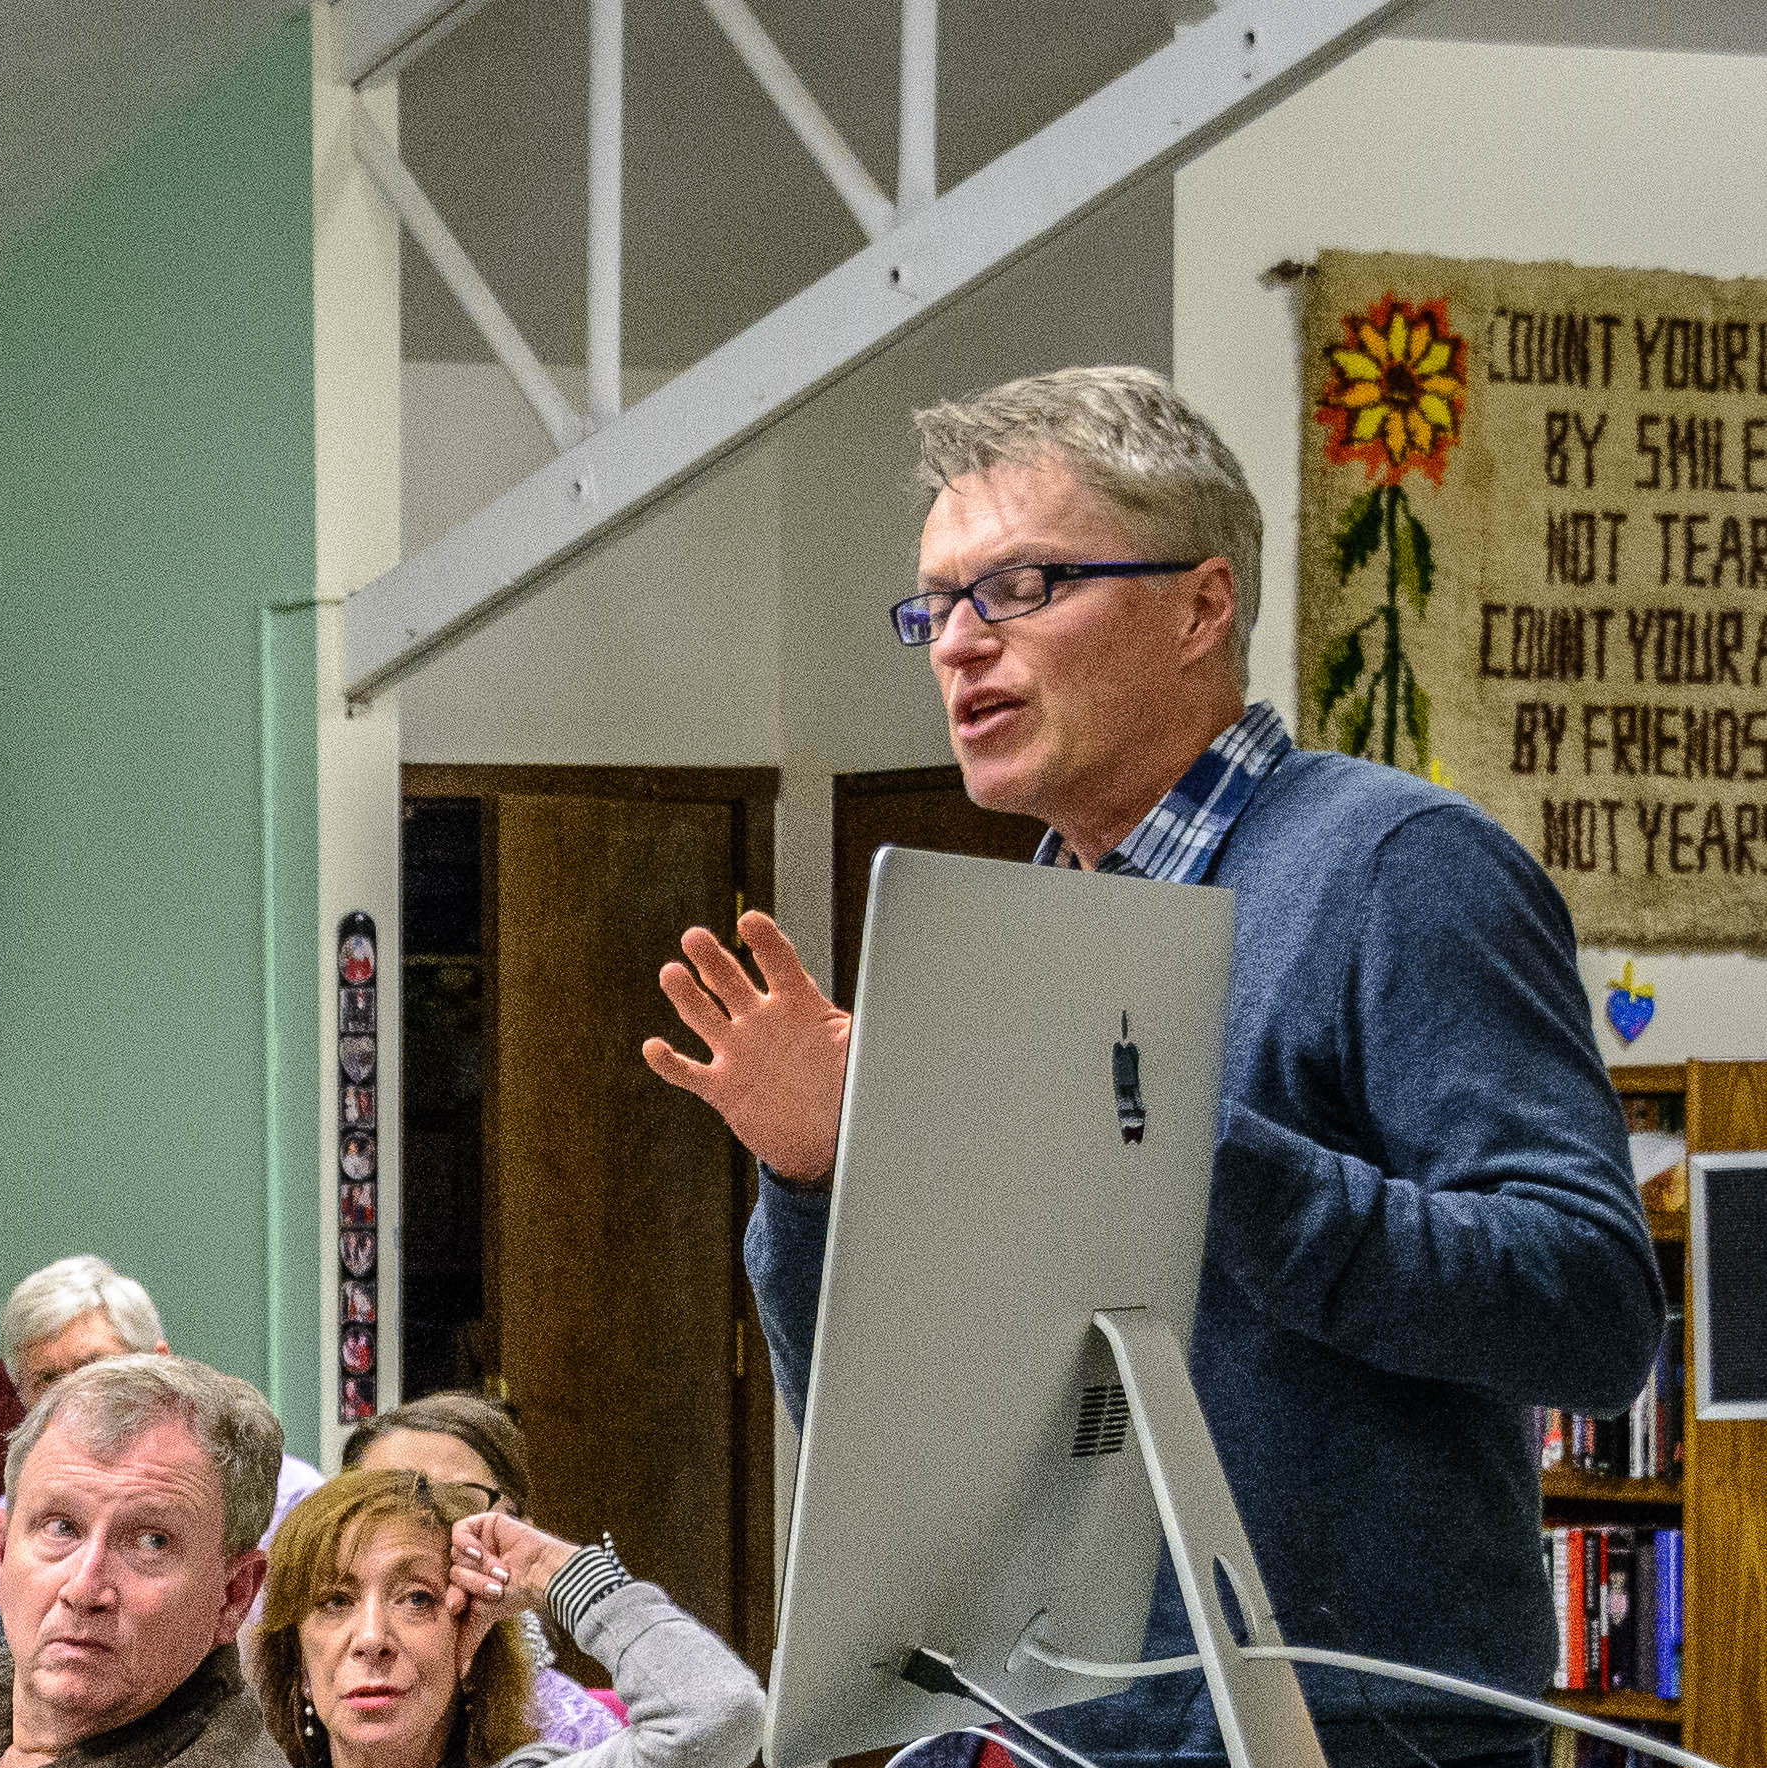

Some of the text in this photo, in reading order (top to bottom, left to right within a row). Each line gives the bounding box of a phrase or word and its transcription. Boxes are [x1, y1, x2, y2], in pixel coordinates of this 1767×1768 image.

[1488, 308, 1622, 387] COUNT
[1634, 316, 1750, 394] YOUR
[1544, 411, 1608, 489] BY
[1545, 511, 1627, 587] NOT
[1478, 602, 1615, 683] COUNT
[1627, 606, 1743, 687] YOUR
[1509, 701, 1767, 783] BY FRIENDS
[1542, 798, 1767, 876] NOT YEAR
